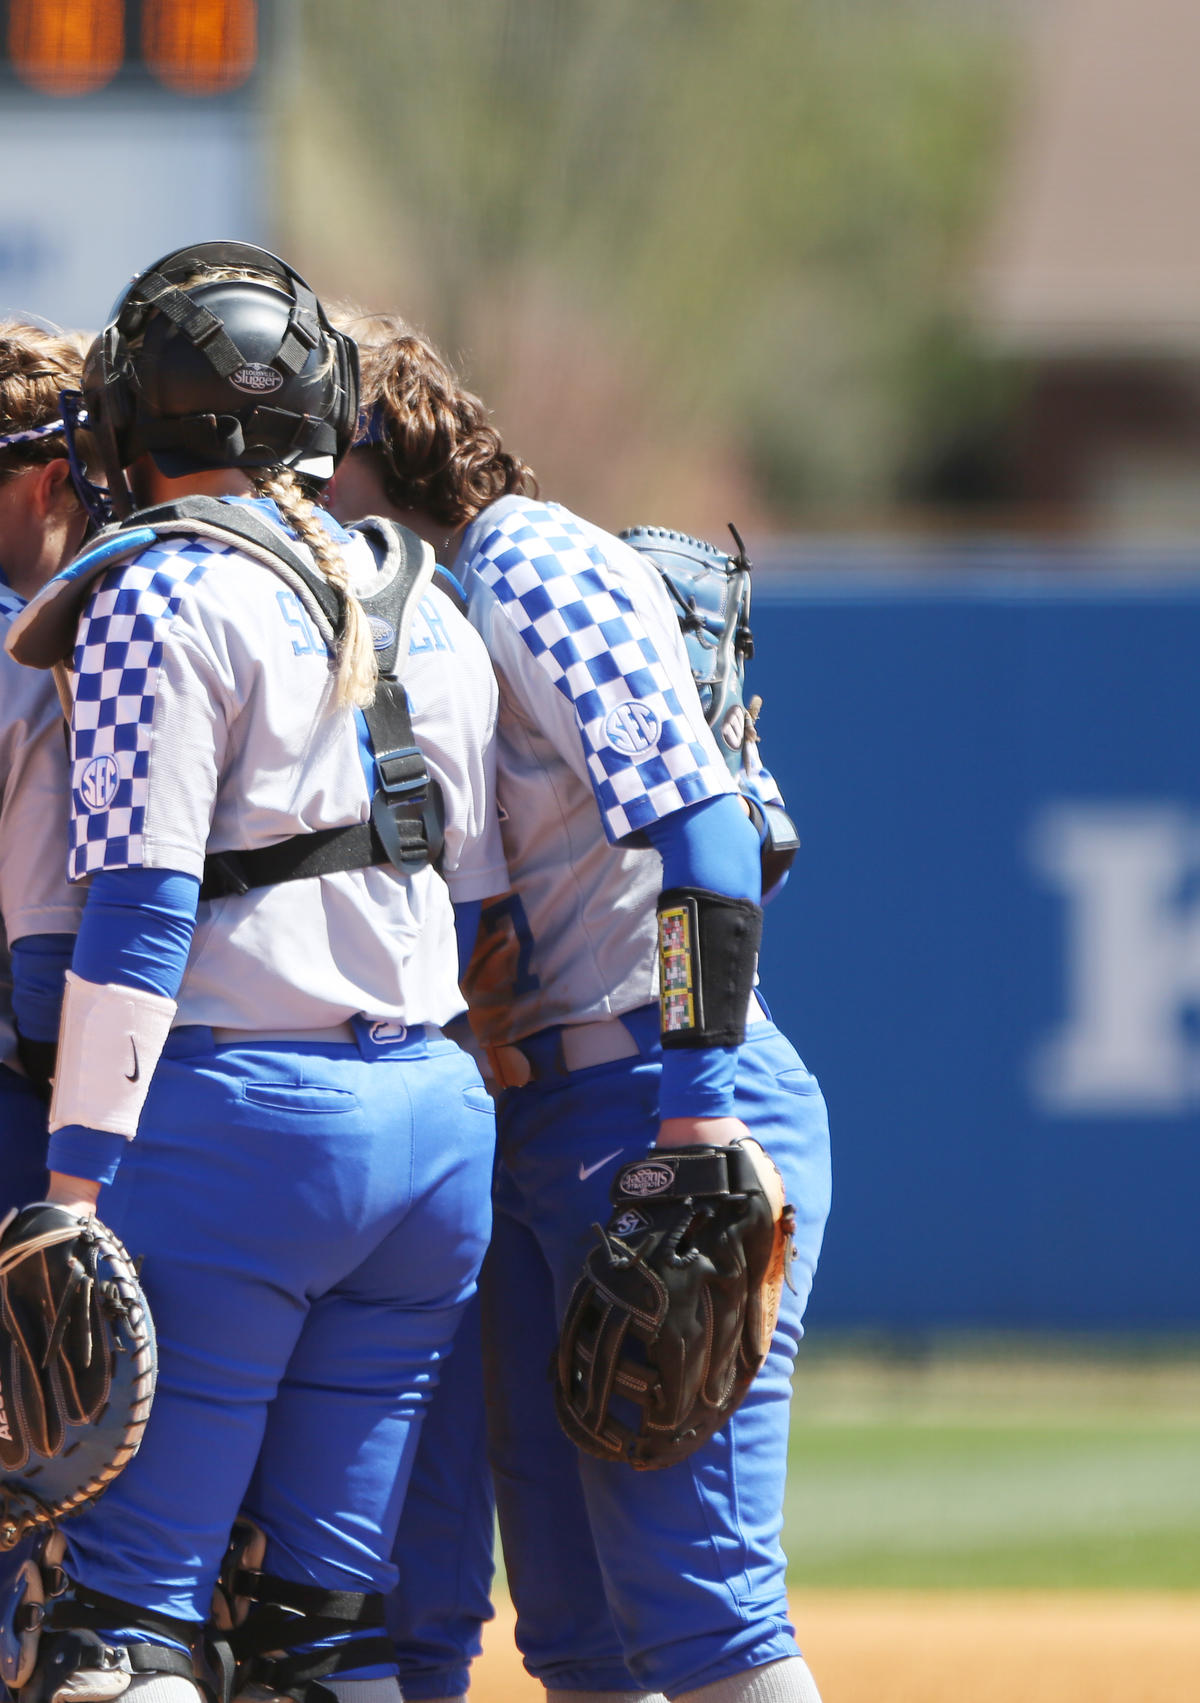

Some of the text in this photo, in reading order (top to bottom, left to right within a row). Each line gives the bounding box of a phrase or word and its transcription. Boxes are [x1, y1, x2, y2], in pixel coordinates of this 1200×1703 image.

[233, 370, 275, 389] Slugger
[606, 703, 657, 753] SEC
[82, 757, 117, 807] SEC
